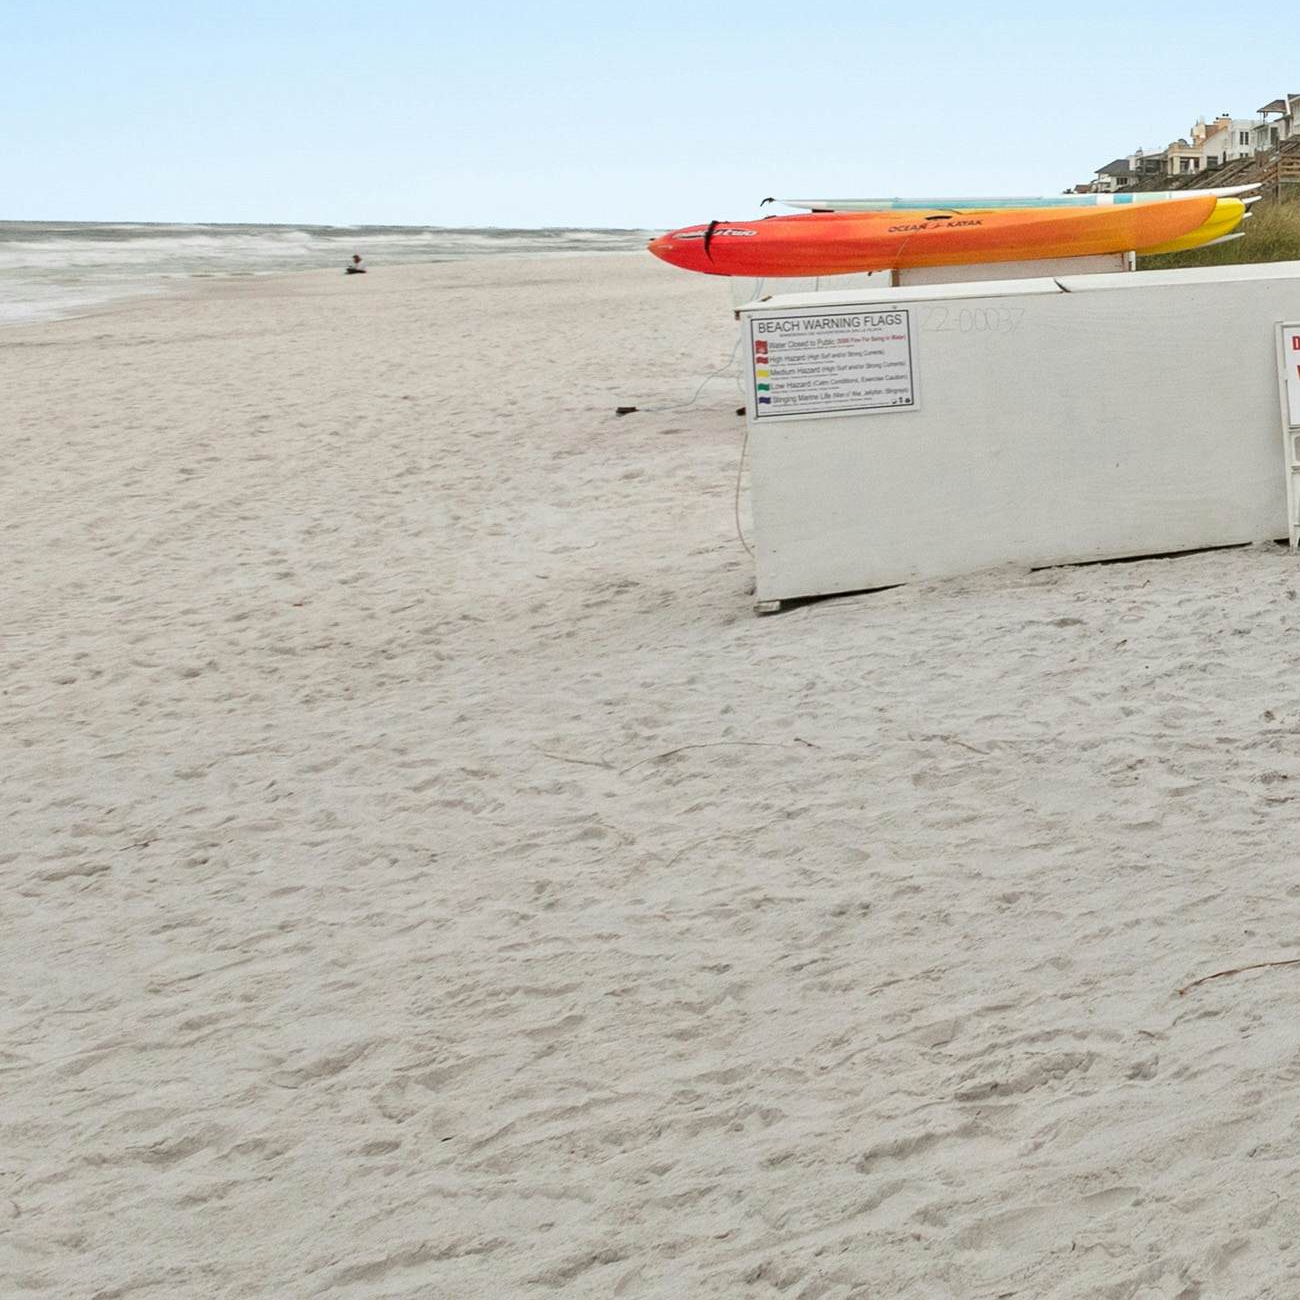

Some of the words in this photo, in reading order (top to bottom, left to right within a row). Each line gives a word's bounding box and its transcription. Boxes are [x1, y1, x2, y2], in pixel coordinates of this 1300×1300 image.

[888, 223, 928, 233] OCEAN
[947, 220, 983, 228] KAYAK
[758, 321, 800, 334] BEACH
[803, 317, 861, 330] WARNING
[863, 314, 902, 327] FLAGS
